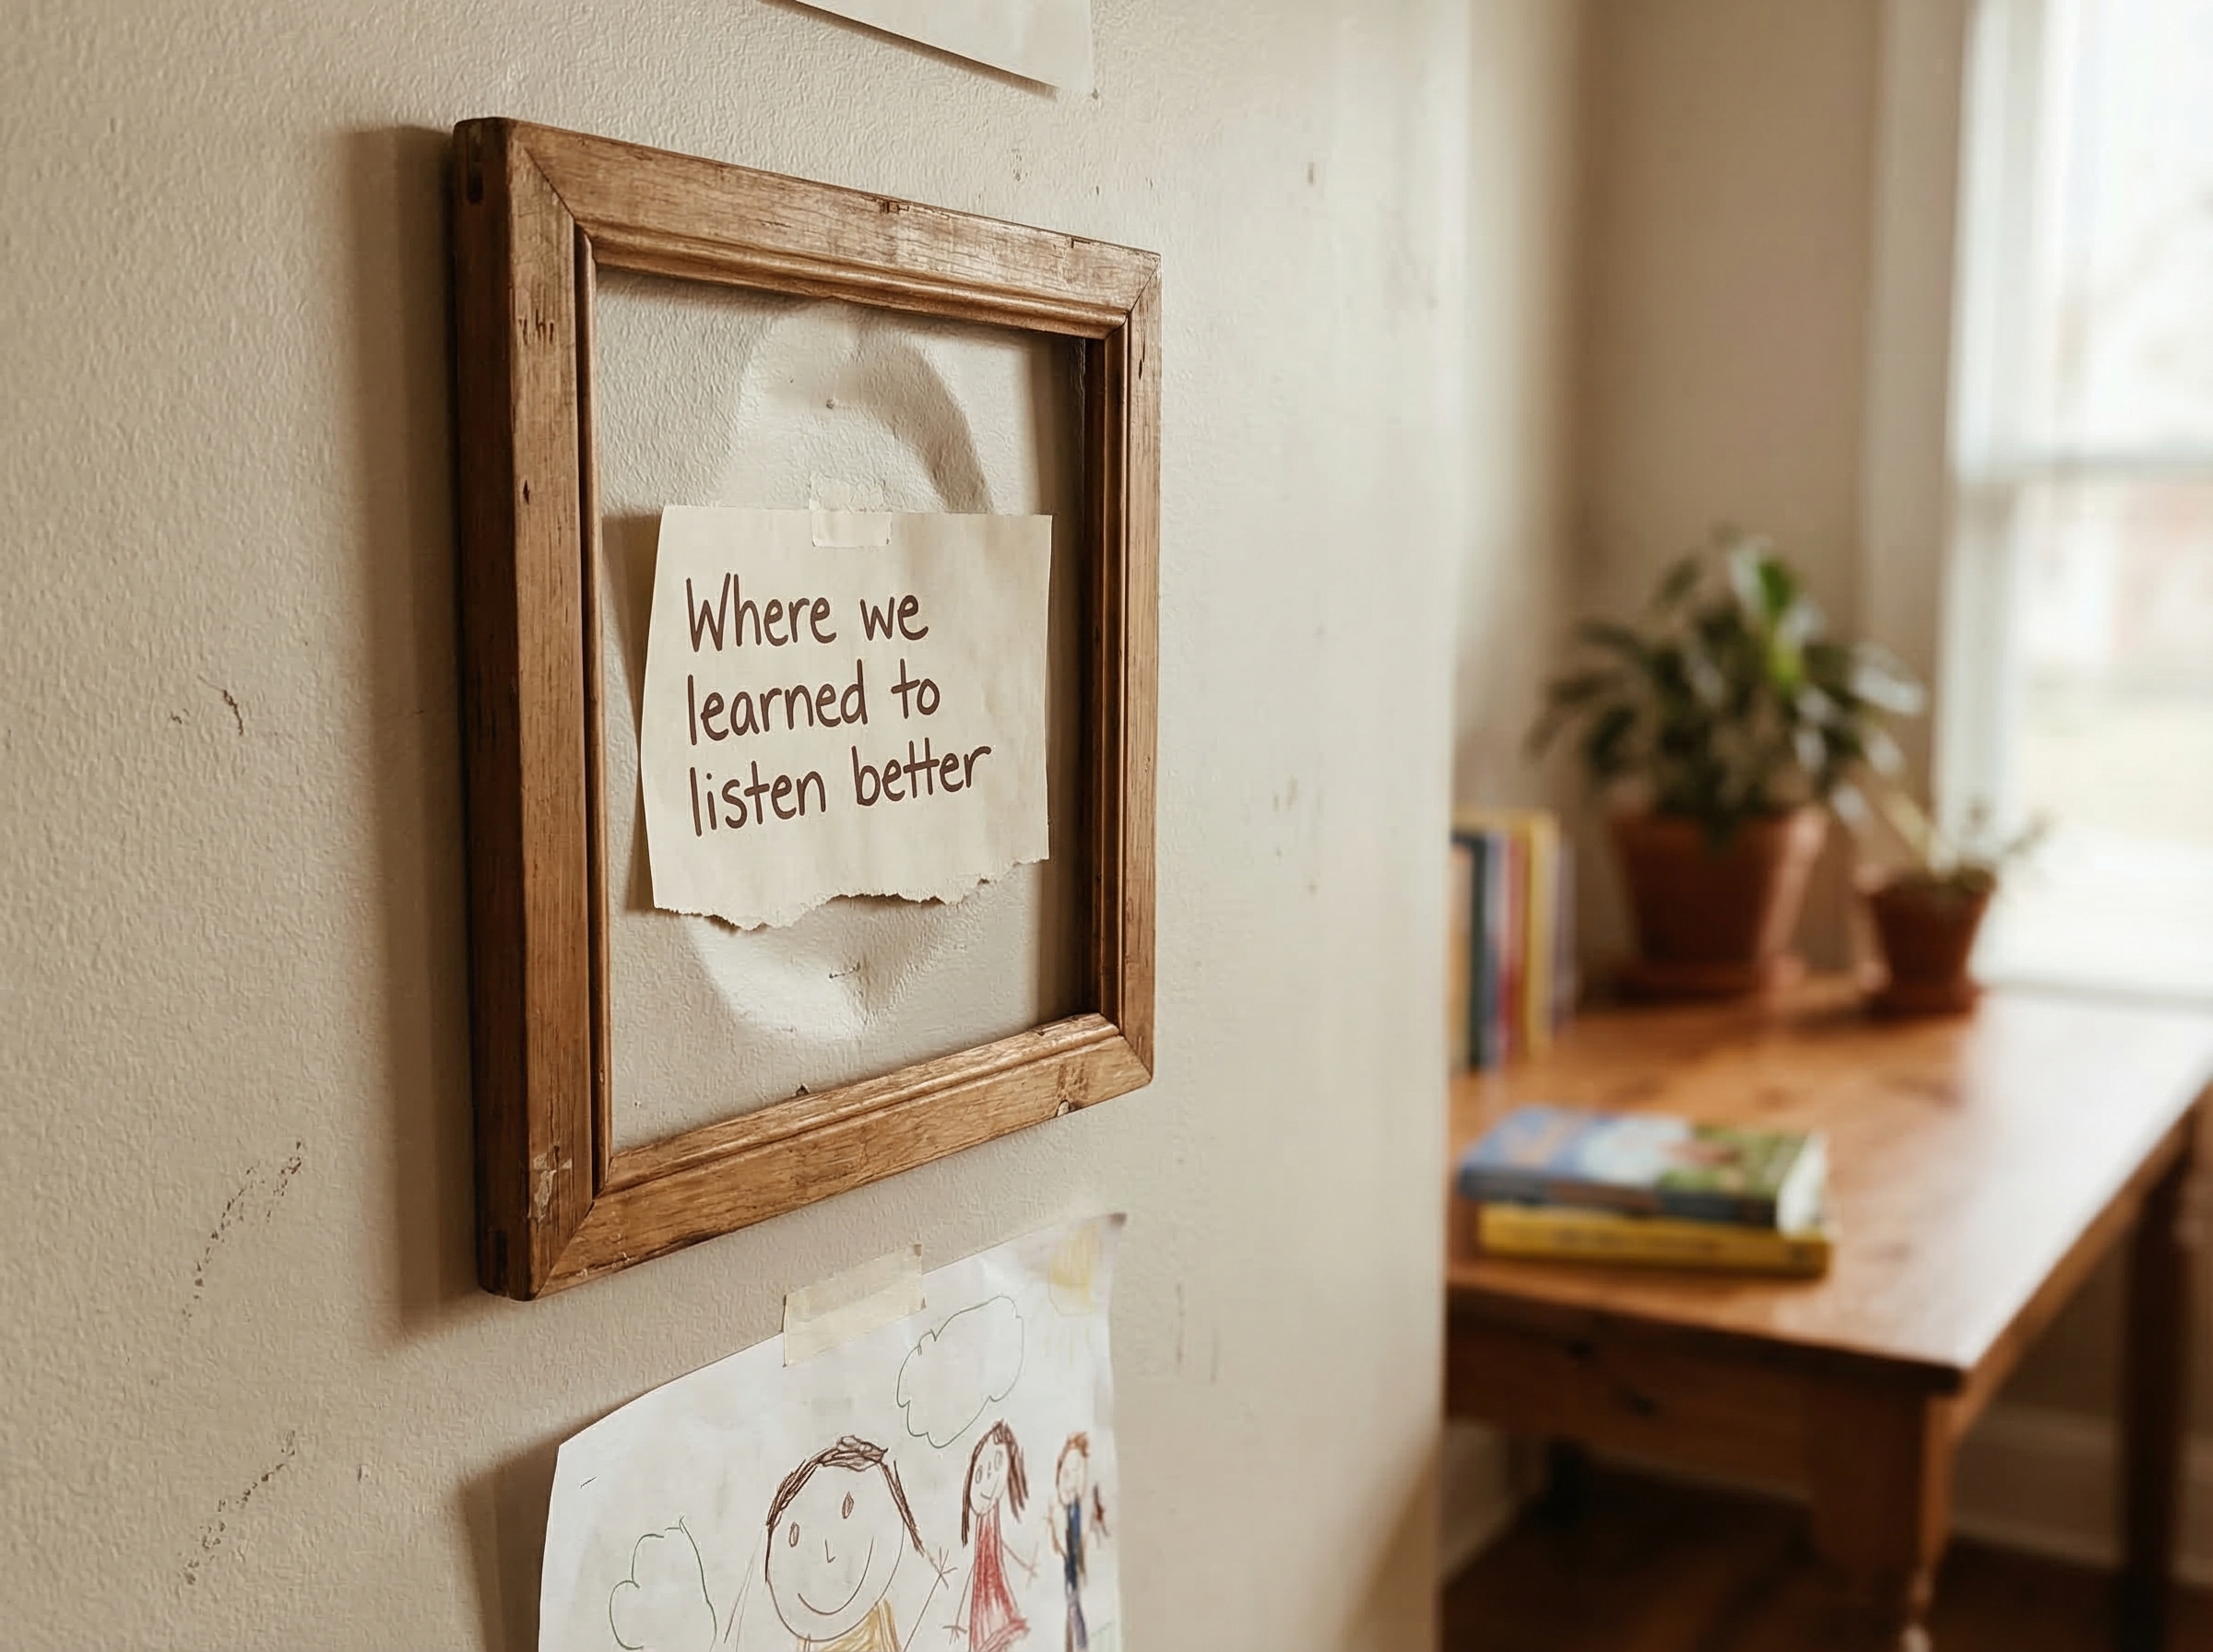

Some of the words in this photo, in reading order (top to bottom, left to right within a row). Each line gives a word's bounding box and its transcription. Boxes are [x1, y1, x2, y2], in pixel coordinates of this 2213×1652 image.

[685, 572, 837, 653] Where
[859, 595, 929, 642] we
[687, 658, 869, 746] learned
[890, 658, 941, 720] to
[689, 760, 826, 837] listen
[851, 737, 992, 807] better
